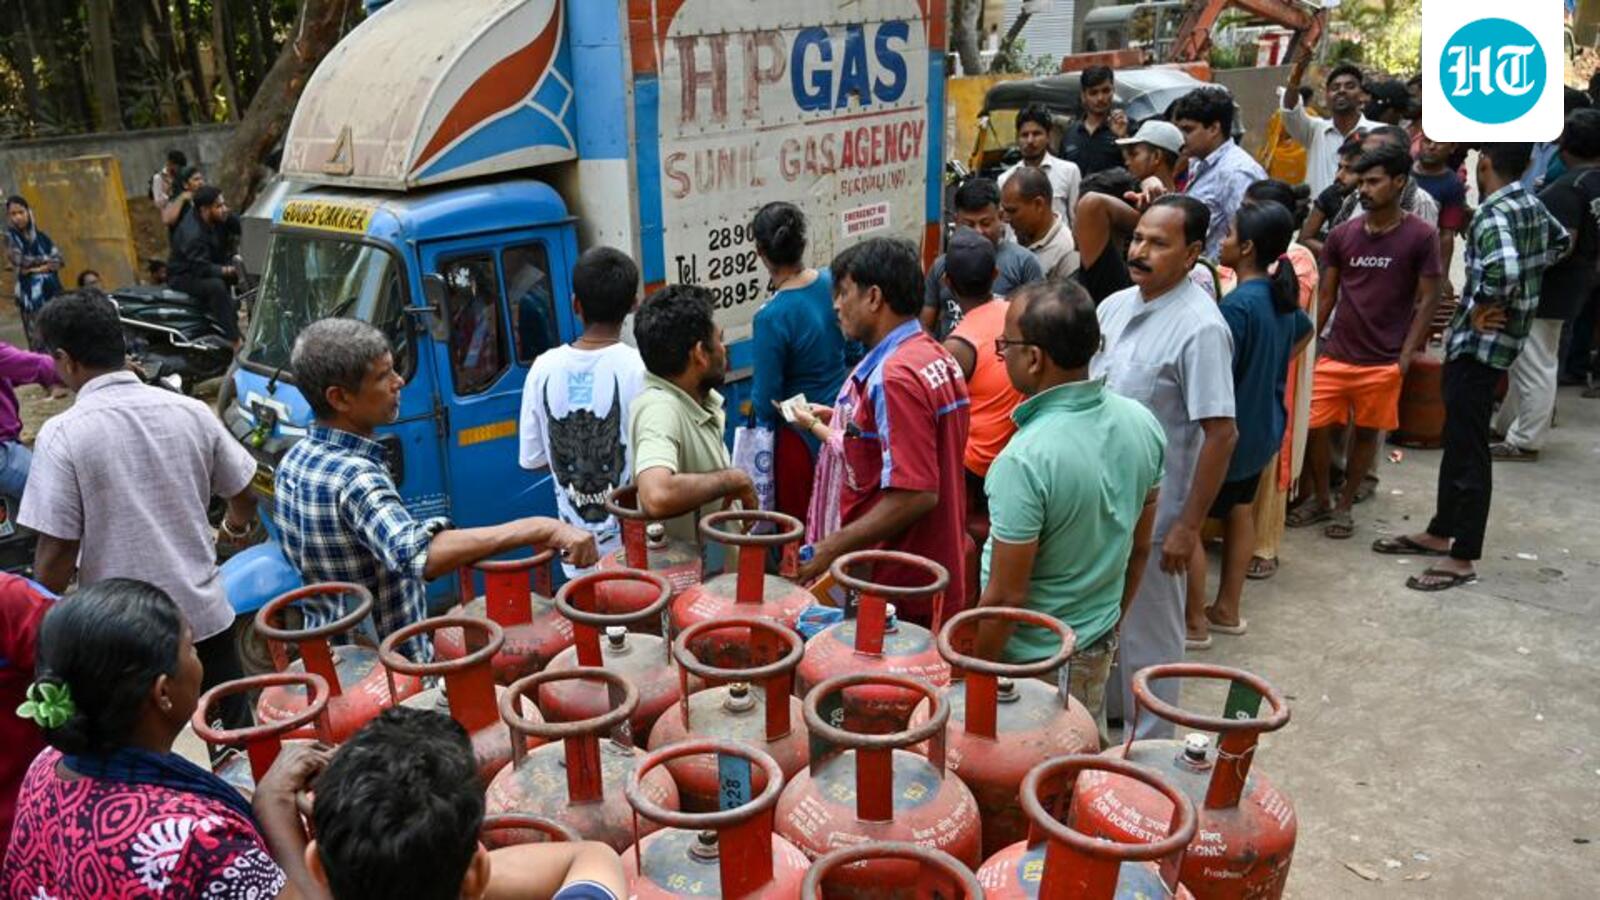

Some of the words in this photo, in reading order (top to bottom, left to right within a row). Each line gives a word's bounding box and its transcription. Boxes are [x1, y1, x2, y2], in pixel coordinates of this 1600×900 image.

[791, 19, 910, 112] GAS
[779, 130, 836, 182] GAS
[840, 120, 925, 169] AGENCY
[708, 222, 755, 251] 2890
[675, 253, 701, 285] Tel.
[708, 250, 758, 280] 2892
[1350, 256, 1393, 269] LACOST
[711, 278, 759, 310] 2895
[1092, 798, 1108, 817] FOR
[1194, 845, 1228, 858] ONLY
